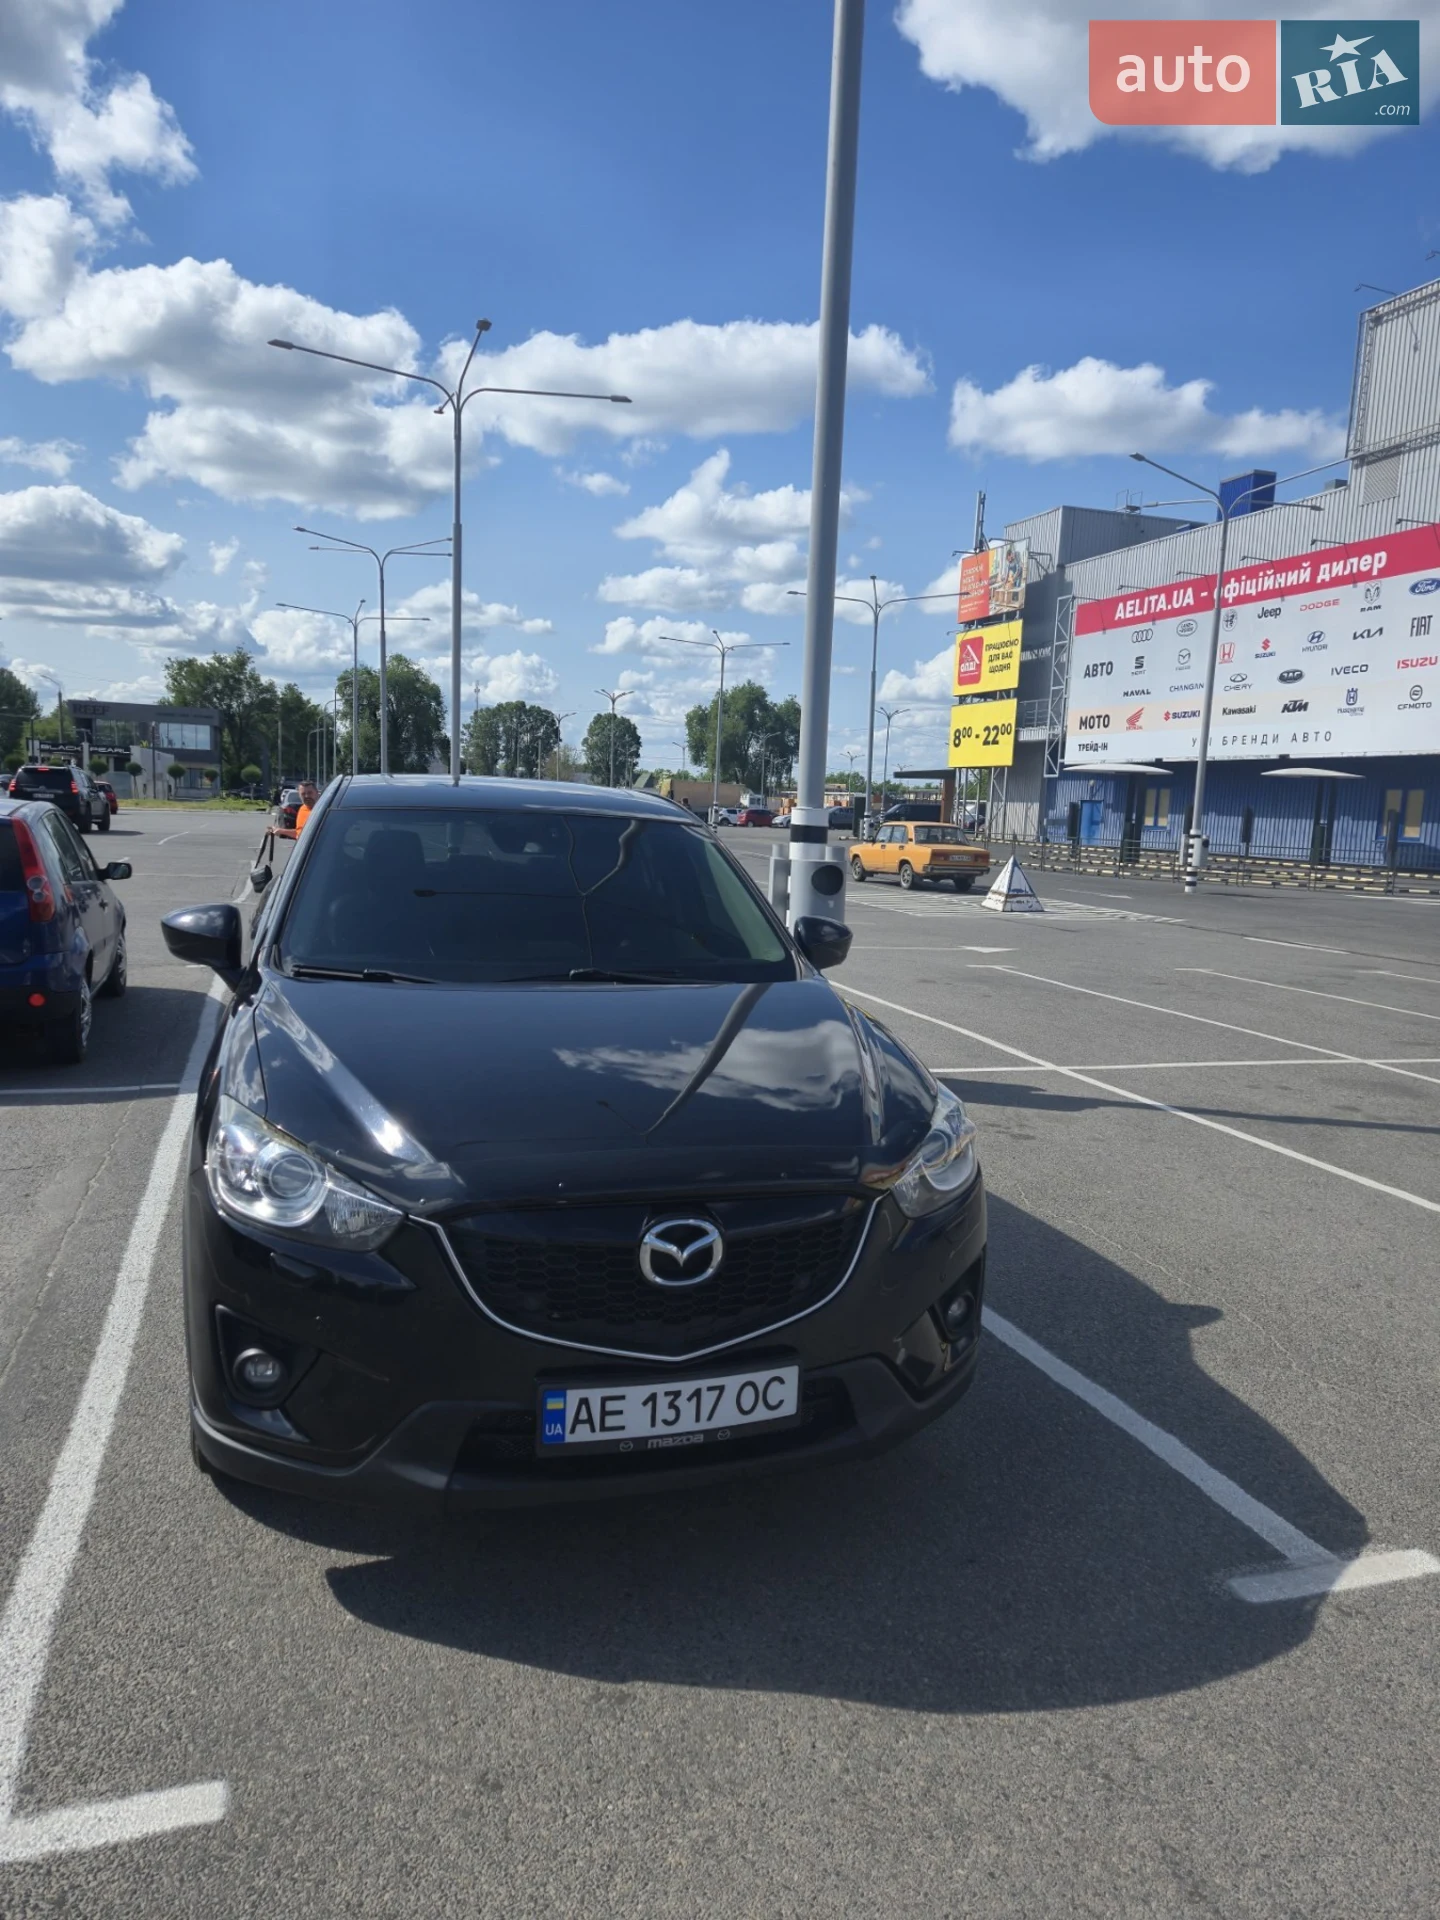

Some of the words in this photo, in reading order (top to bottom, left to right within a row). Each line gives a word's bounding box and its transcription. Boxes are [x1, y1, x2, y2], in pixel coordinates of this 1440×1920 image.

[1114, 586, 1195, 621] AELITA.UA
[1315, 551, 1388, 584] дилер
[1299, 598, 1340, 612] DODGE
[1360, 604, 1382, 612] RAM
[1257, 606, 1282, 619] Jeep
[1410, 614, 1434, 638] FIAT
[985, 638, 1020, 652] ПРАЦЮЄМО
[988, 652, 1001, 663] ДЛЯ
[1001, 650, 1013, 661] ВАС
[1254, 650, 1276, 659] SUZUKI
[988, 662, 1012, 674] ЩОДНЯ
[1396, 655, 1439, 670] ISUZU
[1083, 660, 1114, 679] АВТО
[1331, 663, 1369, 676] IVECO
[1123, 688, 1151, 697] HAVAL
[1169, 682, 1205, 693] CHANGAN
[1223, 682, 1253, 692] CHERY
[1221, 704, 1257, 716] Kawasaki
[1281, 699, 1310, 714] KTM
[1397, 701, 1433, 711] CFMOTO
[1171, 709, 1201, 720] SUZUKI
[1079, 713, 1111, 731] МОТО
[1191, 736, 1212, 747] УІ
[1221, 733, 1280, 747] БРЕНДИ
[1290, 731, 1333, 744] АВТО
[40, 743, 83, 752] BLACK
[89, 745, 131, 754] PEARL
[1078, 740, 1109, 753] ТРЕЙД-ІН
[568, 1394, 627, 1436] AE
[641, 1384, 726, 1429] 1317
[735, 1375, 786, 1417] OC
[544, 1423, 564, 1436] UA
[647, 1433, 704, 1449] mazda
